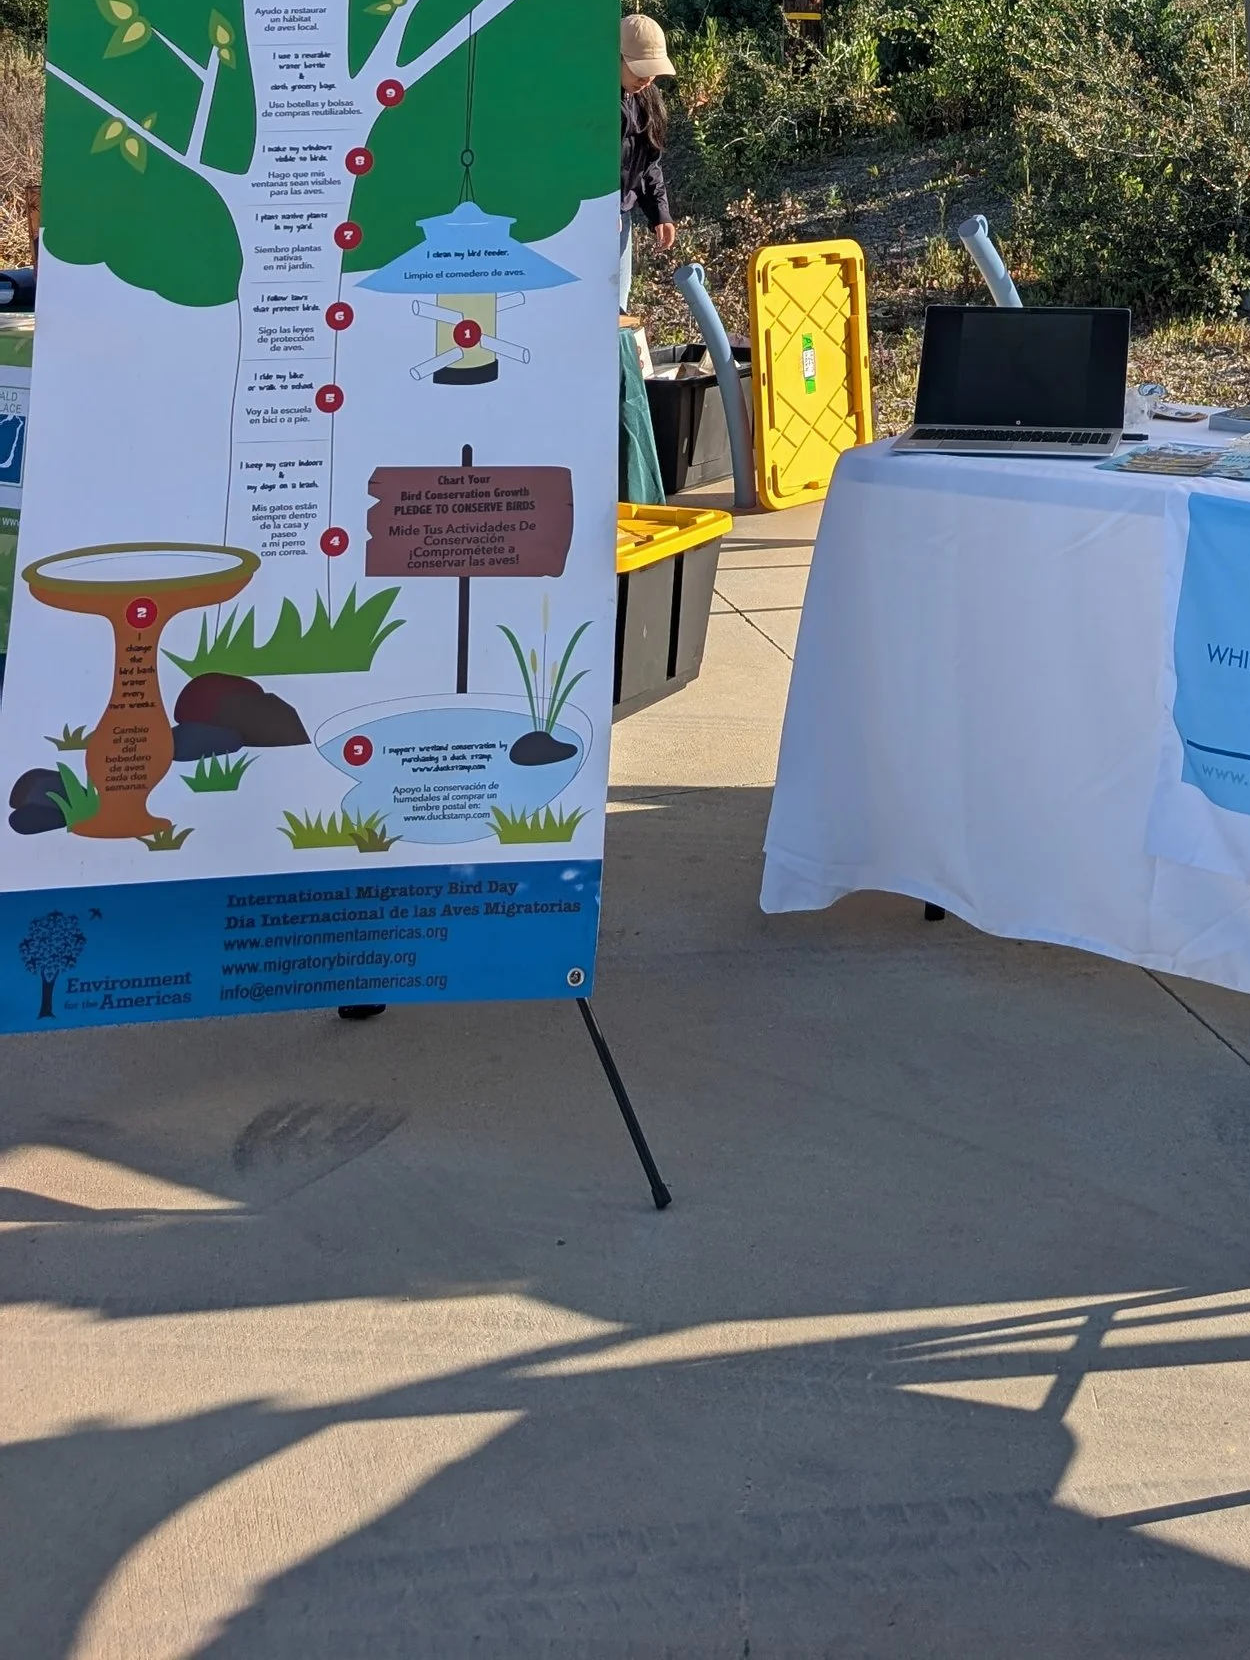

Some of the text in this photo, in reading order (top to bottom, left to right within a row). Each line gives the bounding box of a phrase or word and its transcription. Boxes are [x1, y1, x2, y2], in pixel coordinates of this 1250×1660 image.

[255, 8, 282, 16] Ayudo
[386, 88, 396, 97] 9
[275, 109, 310, 118] compras
[355, 156, 365, 165] 8
[268, 171, 290, 180] Hago
[270, 189, 288, 197] para
[344, 231, 353, 239] 7
[292, 245, 321, 254] plantas
[455, 252, 464, 260] my
[468, 249, 481, 257] bird
[289, 262, 314, 271] jardín.
[404, 272, 433, 280] Limpio
[446, 270, 488, 278] comedero
[335, 312, 344, 320] 6
[259, 326, 277, 335] Sigo
[293, 326, 314, 335] leyes
[464, 329, 470, 338] 1
[271, 335, 314, 345] protección
[326, 394, 335, 402] 5
[246, 408, 261, 416] Voy
[294, 415, 310, 424] pie.
[438, 475, 490, 485] Chart Your
[401, 487, 529, 501] Bird Conservation Growth
[395, 501, 535, 515] PLEDGE TO CONSERVE BIRDS
[252, 513, 286, 521] siempre
[389, 521, 536, 536] Mide Tus Actividades De
[271, 531, 297, 539] paseo
[282, 540, 305, 548] perro
[330, 536, 340, 546] 4
[424, 534, 504, 546] Conservación
[410, 546, 504, 560] ¡Comprométete
[408, 555, 518, 569] conservar las aves!
[137, 608, 147, 618] 2
[354, 746, 363, 755] 3
[393, 786, 421, 794] Apoyo
[434, 783, 486, 792] conservación
[488, 782, 499, 790] de
[394, 794, 440, 803] humedales
[443, 793, 449, 801] al
[452, 793, 485, 802] comprar
[412, 803, 439, 811] timbre
[442, 802, 466, 811] postal
[404, 812, 490, 821] www.duckstamp.com
[226, 880, 519, 908] International Migratory Bird Day
[261, 906, 384, 926] Internacional
[389, 906, 408, 919] de
[414, 904, 436, 918] las
[440, 903, 479, 916] Aves
[484, 900, 581, 917] Migratorias
[224, 926, 448, 951] www.environmentamericas.org
[222, 951, 416, 975] www.migratorybirdday.org
[66, 972, 192, 993] Environment
[220, 973, 447, 1002] info@environmentamericas.org
[64, 991, 192, 1010] for the Americas
